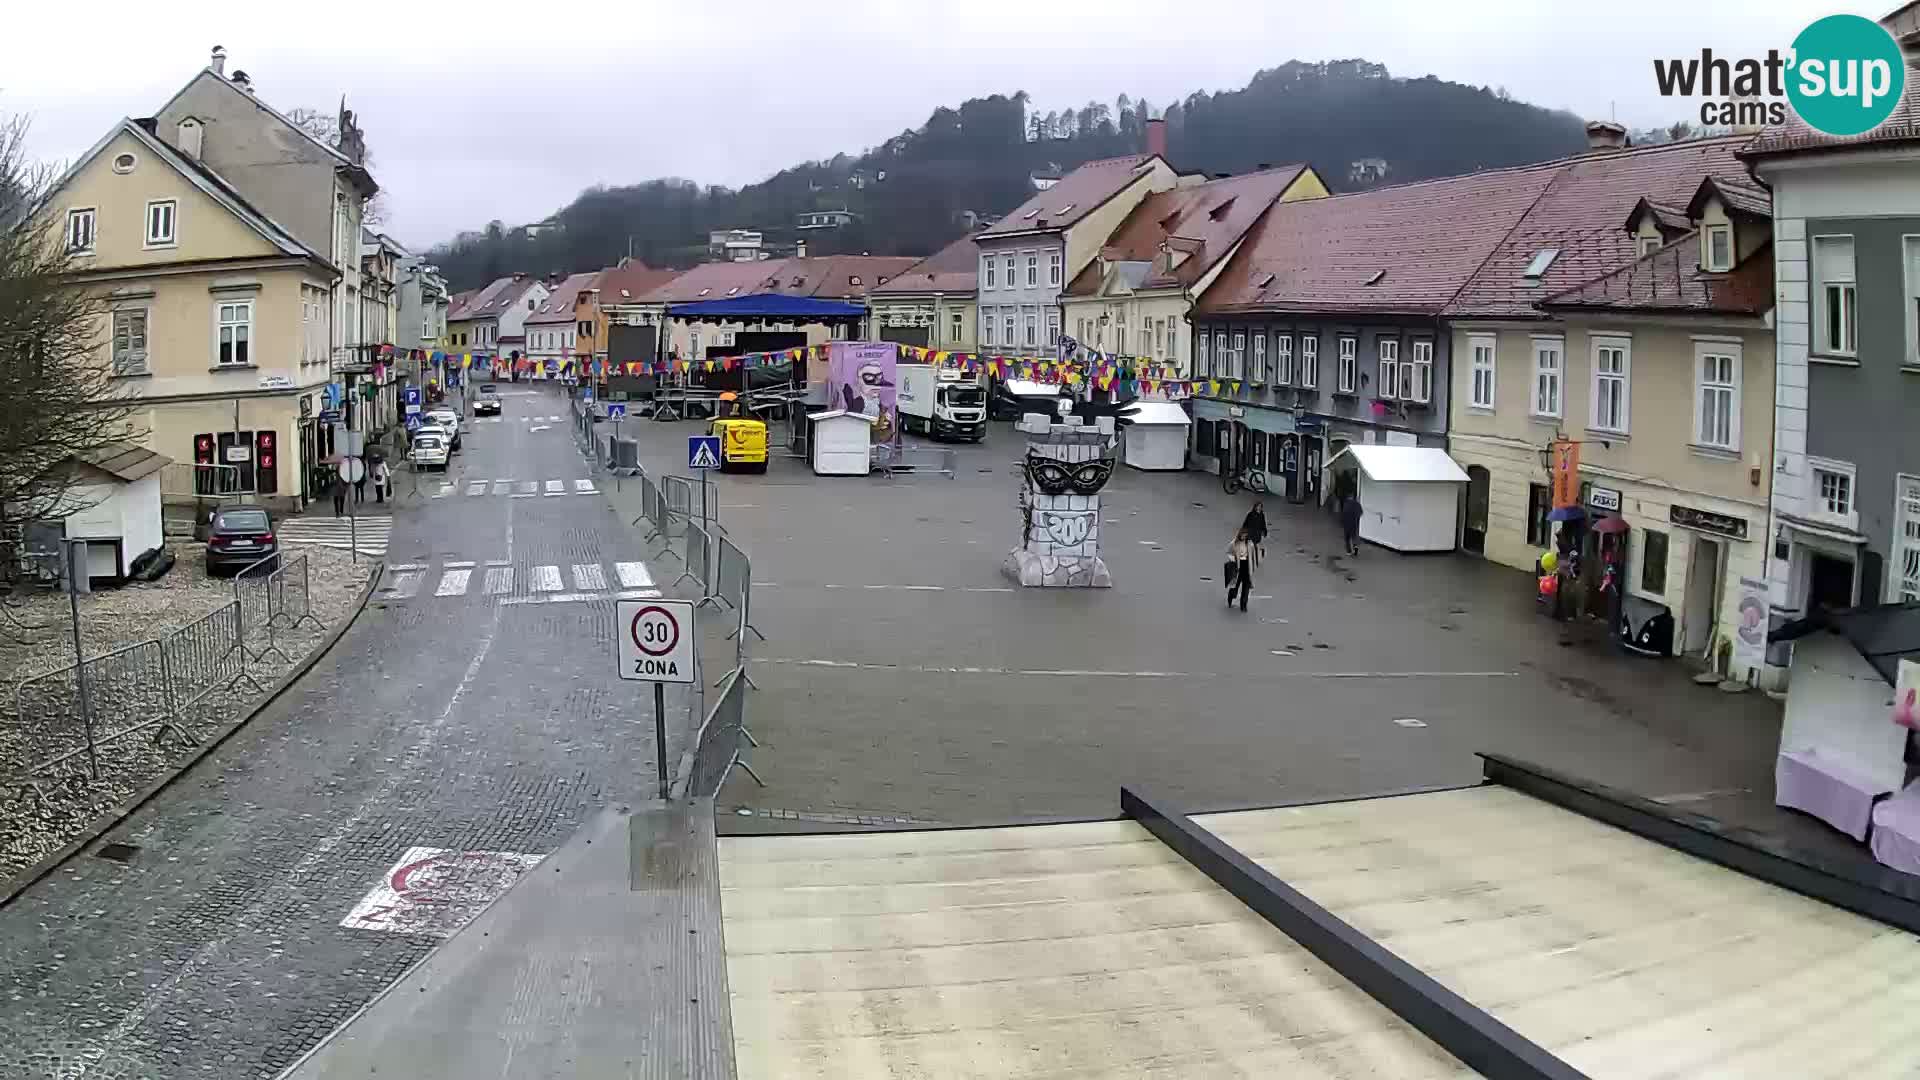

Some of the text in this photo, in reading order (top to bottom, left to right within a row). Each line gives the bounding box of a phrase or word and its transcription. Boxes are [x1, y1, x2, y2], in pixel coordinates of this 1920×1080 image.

[409, 391, 417, 402] P
[1047, 516, 1088, 543] 200
[644, 621, 668, 643] 30
[634, 659, 679, 677] ZONA
